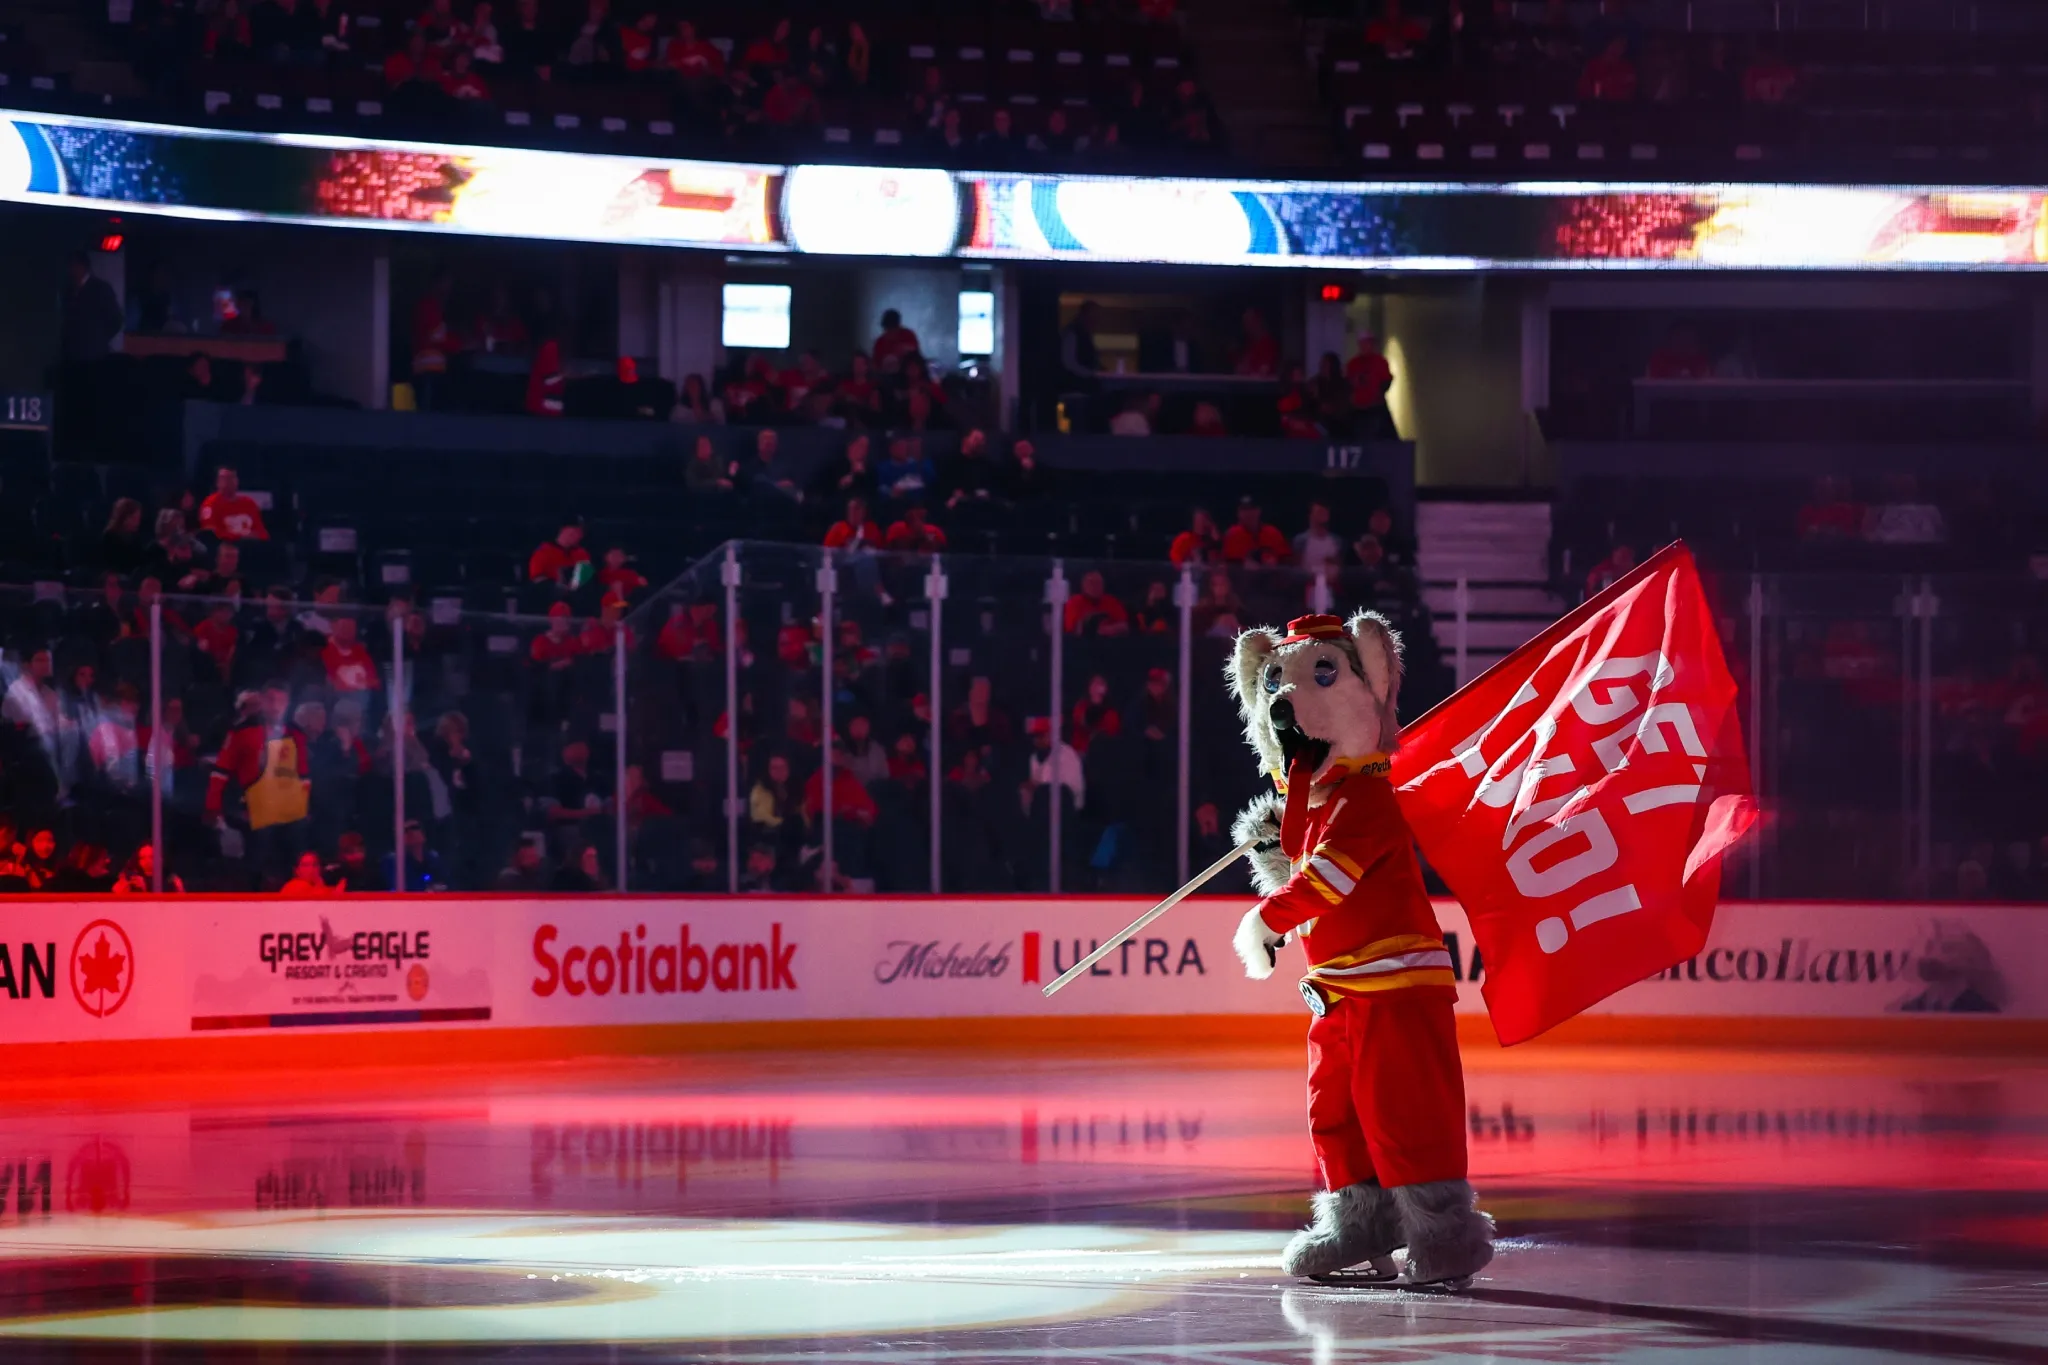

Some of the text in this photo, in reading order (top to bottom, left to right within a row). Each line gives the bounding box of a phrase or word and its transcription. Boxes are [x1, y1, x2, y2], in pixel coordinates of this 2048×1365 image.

[8, 396, 41, 421] 118
[1326, 445, 1362, 469] 117
[1569, 649, 1712, 815] GET
[260, 930, 430, 973] GREY EAGLE
[531, 922, 797, 997] Scotiabank
[874, 939, 1206, 984] Michelob ULTRA
